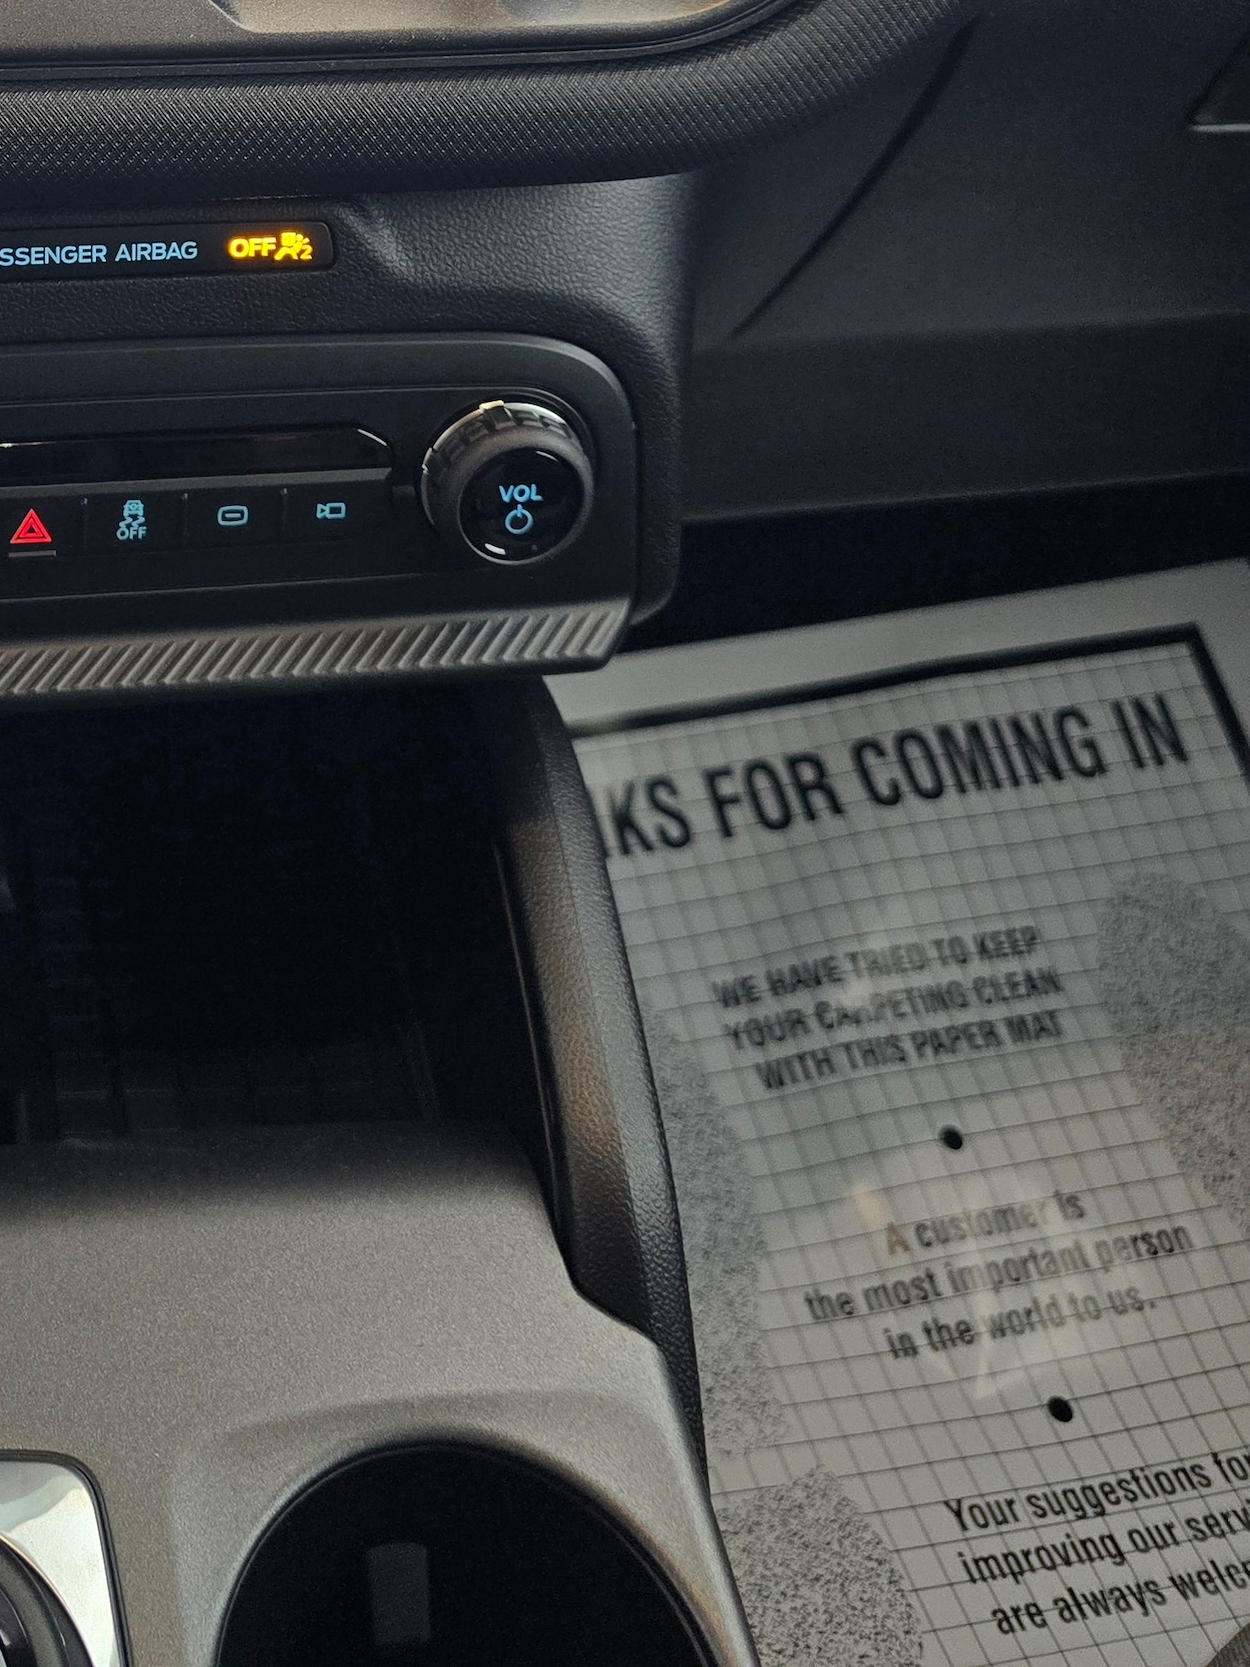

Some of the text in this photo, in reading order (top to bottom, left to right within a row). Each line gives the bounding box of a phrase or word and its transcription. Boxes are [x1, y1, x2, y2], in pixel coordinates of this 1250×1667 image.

[114, 241, 198, 264] AIRBAG
[228, 235, 277, 260] OFF
[499, 483, 544, 503] VOL
[116, 525, 147, 542] OFF
[703, 752, 844, 838] FOR
[854, 705, 1106, 807] COMING
[1110, 692, 1190, 768] IN
[713, 925, 1040, 1008] WE HAVE TRIED TO KEEP
[723, 1008, 811, 1050] YOUR
[973, 966, 1064, 1005] CLEAN
[755, 1008, 1063, 1090] WITH THIS PAPER MAT
[884, 1222, 911, 1255] A
[1055, 1189, 1087, 1222] is
[803, 1287, 855, 1322] the
[861, 1267, 941, 1313] most
[1092, 1223, 1194, 1273] person
[882, 1285, 1156, 1359] in the world to us.
[944, 1495, 1020, 1532] Your
[1026, 1461, 1212, 1520] suggestions
[957, 1531, 1126, 1584] improving
[1127, 1520, 1180, 1554] our
[991, 1600, 1048, 1635] are
[1053, 1578, 1167, 1624] always
